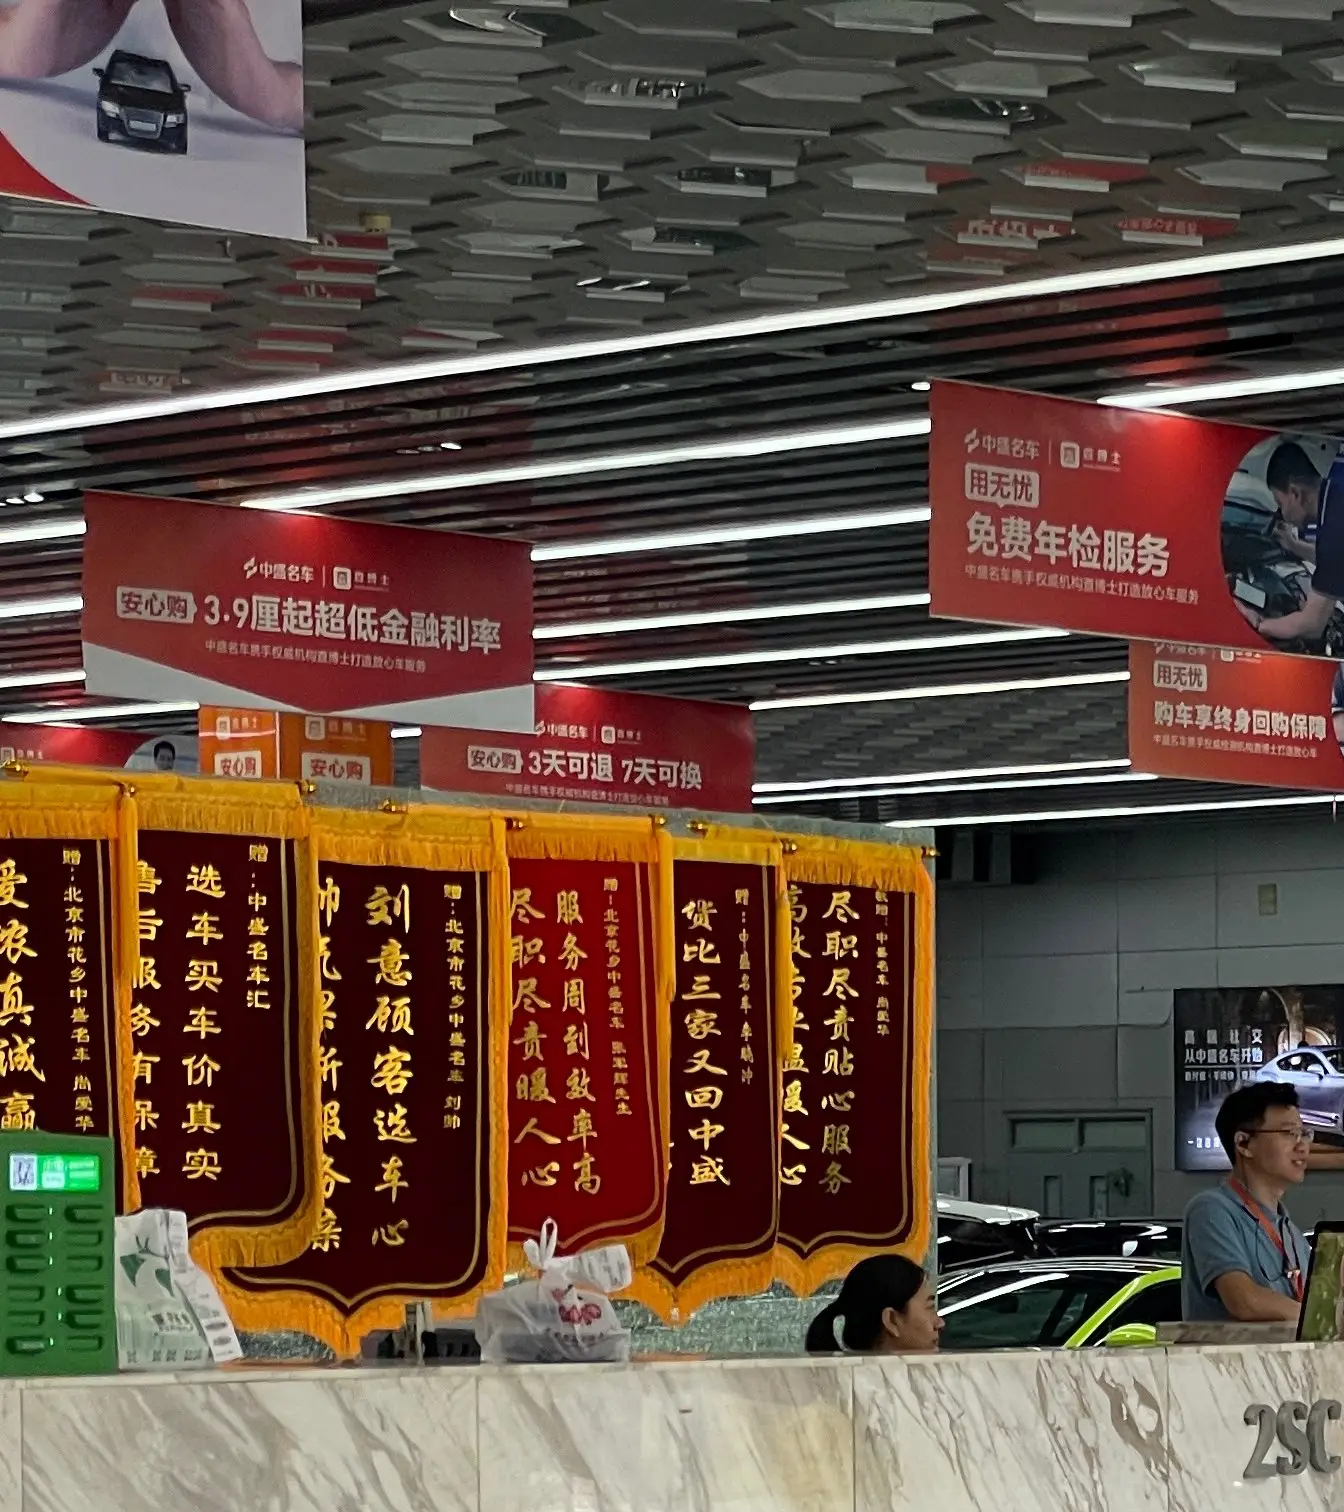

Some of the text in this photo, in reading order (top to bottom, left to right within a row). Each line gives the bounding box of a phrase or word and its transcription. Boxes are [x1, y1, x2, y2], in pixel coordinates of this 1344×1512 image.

[970, 468, 1033, 502] 用无忧
[259, 561, 314, 583] 中盛名车
[966, 511, 1170, 577] 免费年检服务
[120, 591, 501, 654] 安心购 3.9厘起超低金融利率
[1157, 663, 1203, 688] 用无忧
[1153, 700, 1327, 741] 购车享终身回购保障
[309, 759, 363, 779] 安心购
[470, 749, 702, 790] 安心购 3天可退 7天可换
[181, 864, 226, 1181] 选车买车价真实
[510, 887, 562, 1187] 尽职尽责暖人心
[557, 889, 601, 1196] 服务周到效率高
[681, 898, 731, 1186] 货比三家又回中盛
[818, 890, 860, 1194] 尽职尽责贴心服务
